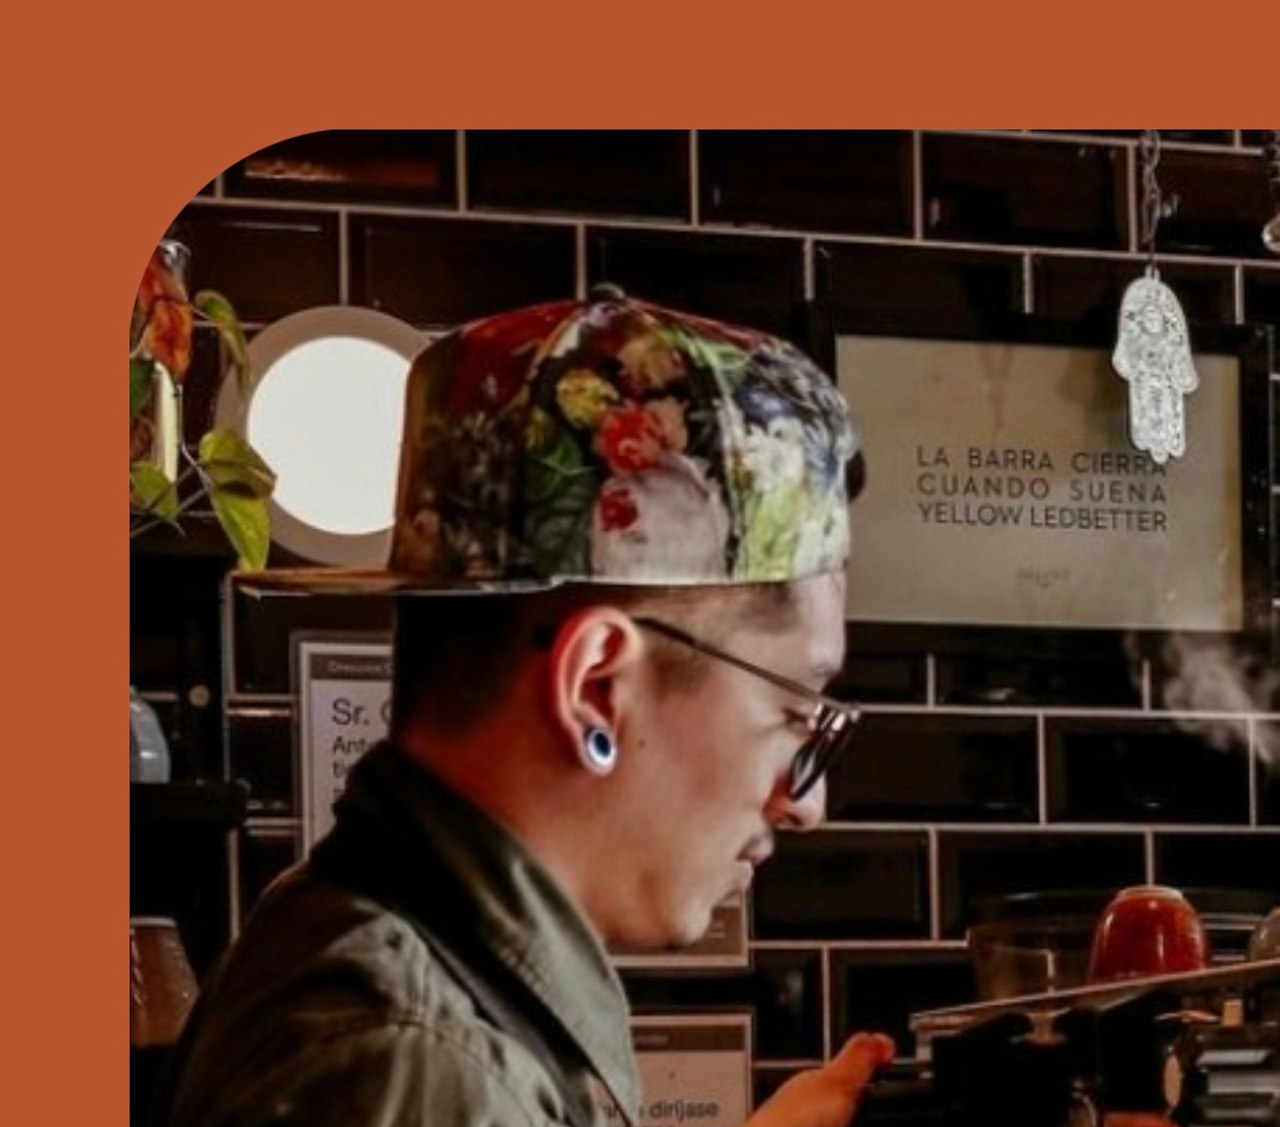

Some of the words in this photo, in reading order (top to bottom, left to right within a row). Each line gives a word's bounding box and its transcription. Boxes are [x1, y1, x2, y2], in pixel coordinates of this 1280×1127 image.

[917, 446, 950, 469] LA
[968, 447, 1053, 472] BARRA
[1070, 451, 1168, 477] CIERRA
[916, 472, 1050, 500] CUANDO
[1069, 479, 1168, 505] SUENA
[917, 502, 1021, 527] YELLOW
[1030, 507, 1168, 533] LEDBETTER
[332, 697, 371, 726] Sr.
